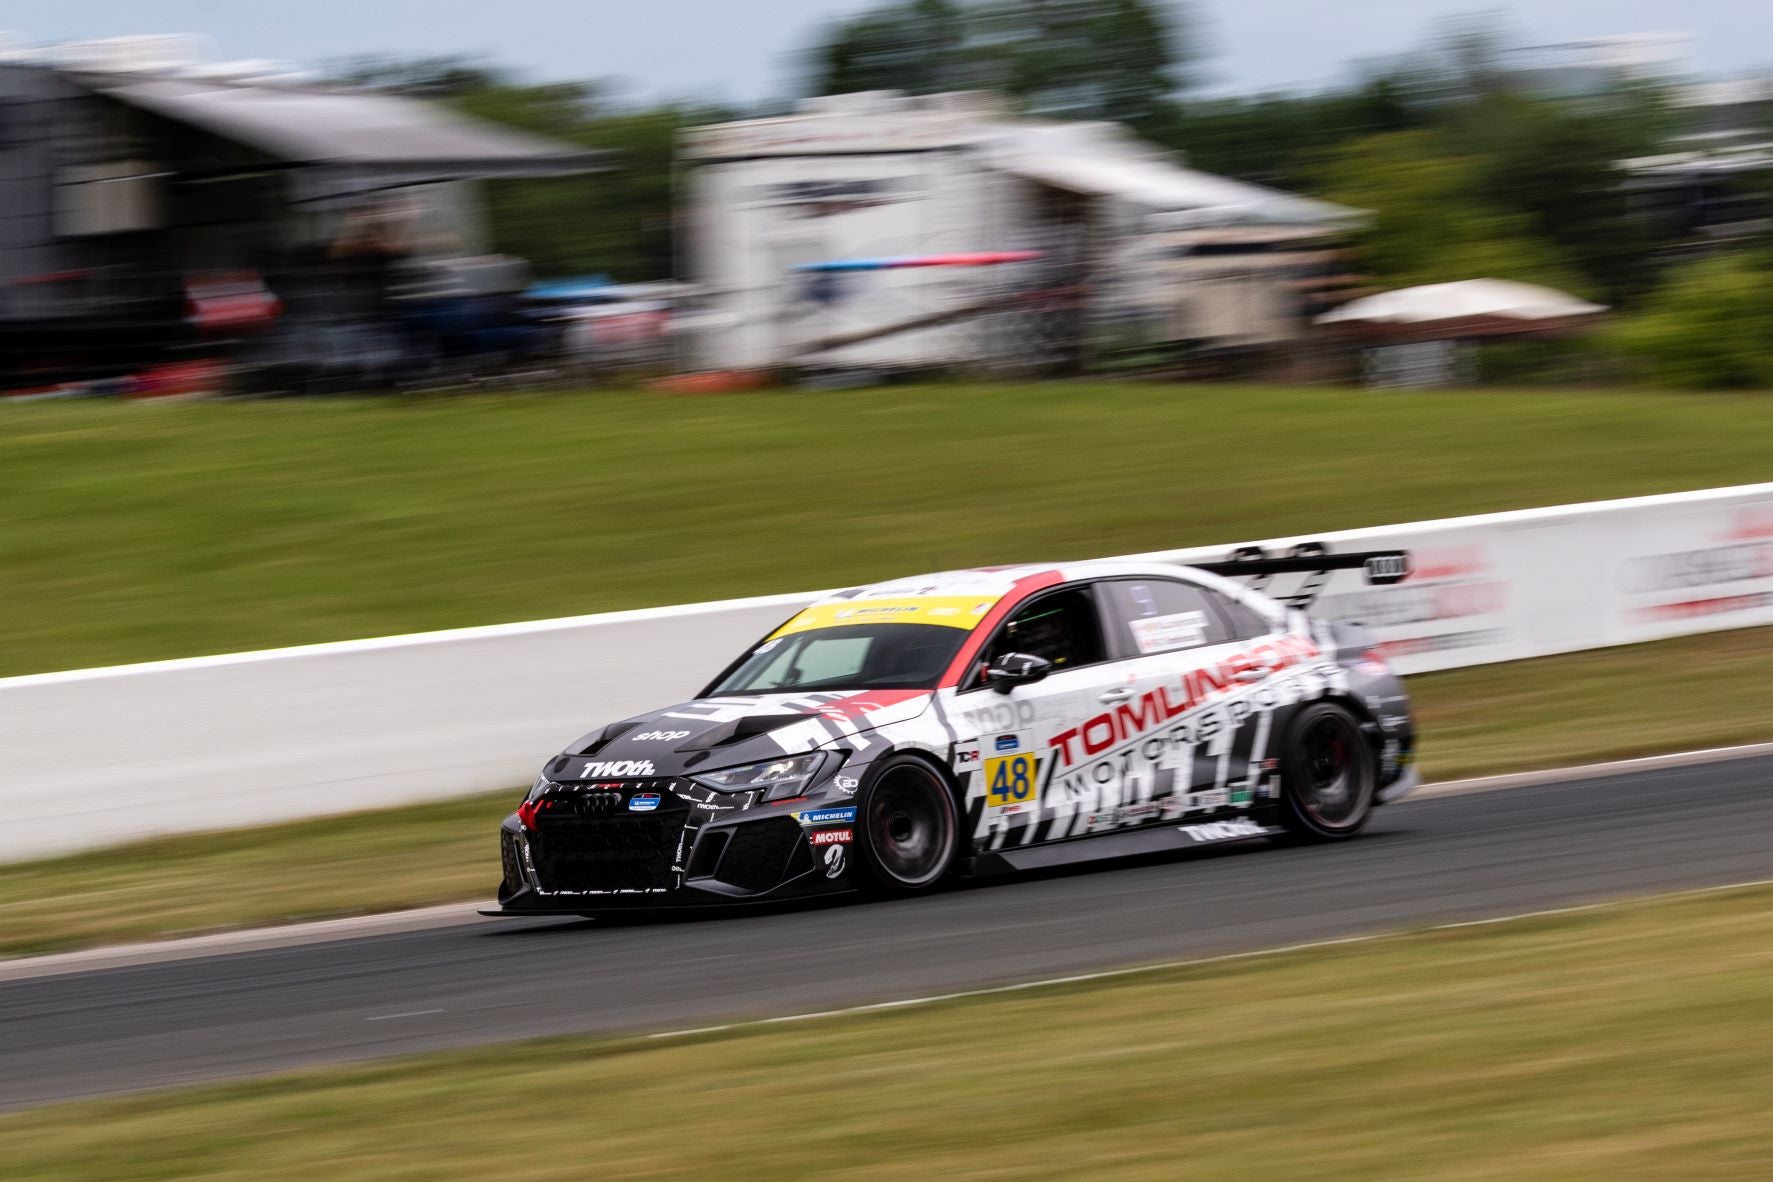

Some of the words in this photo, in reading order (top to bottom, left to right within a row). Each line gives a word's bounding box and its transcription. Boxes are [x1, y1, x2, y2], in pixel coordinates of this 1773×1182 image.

[632, 731, 691, 741] shop
[991, 756, 1029, 802] 48
[813, 811, 853, 821] MICHELIN
[815, 831, 851, 843] MOTUL
